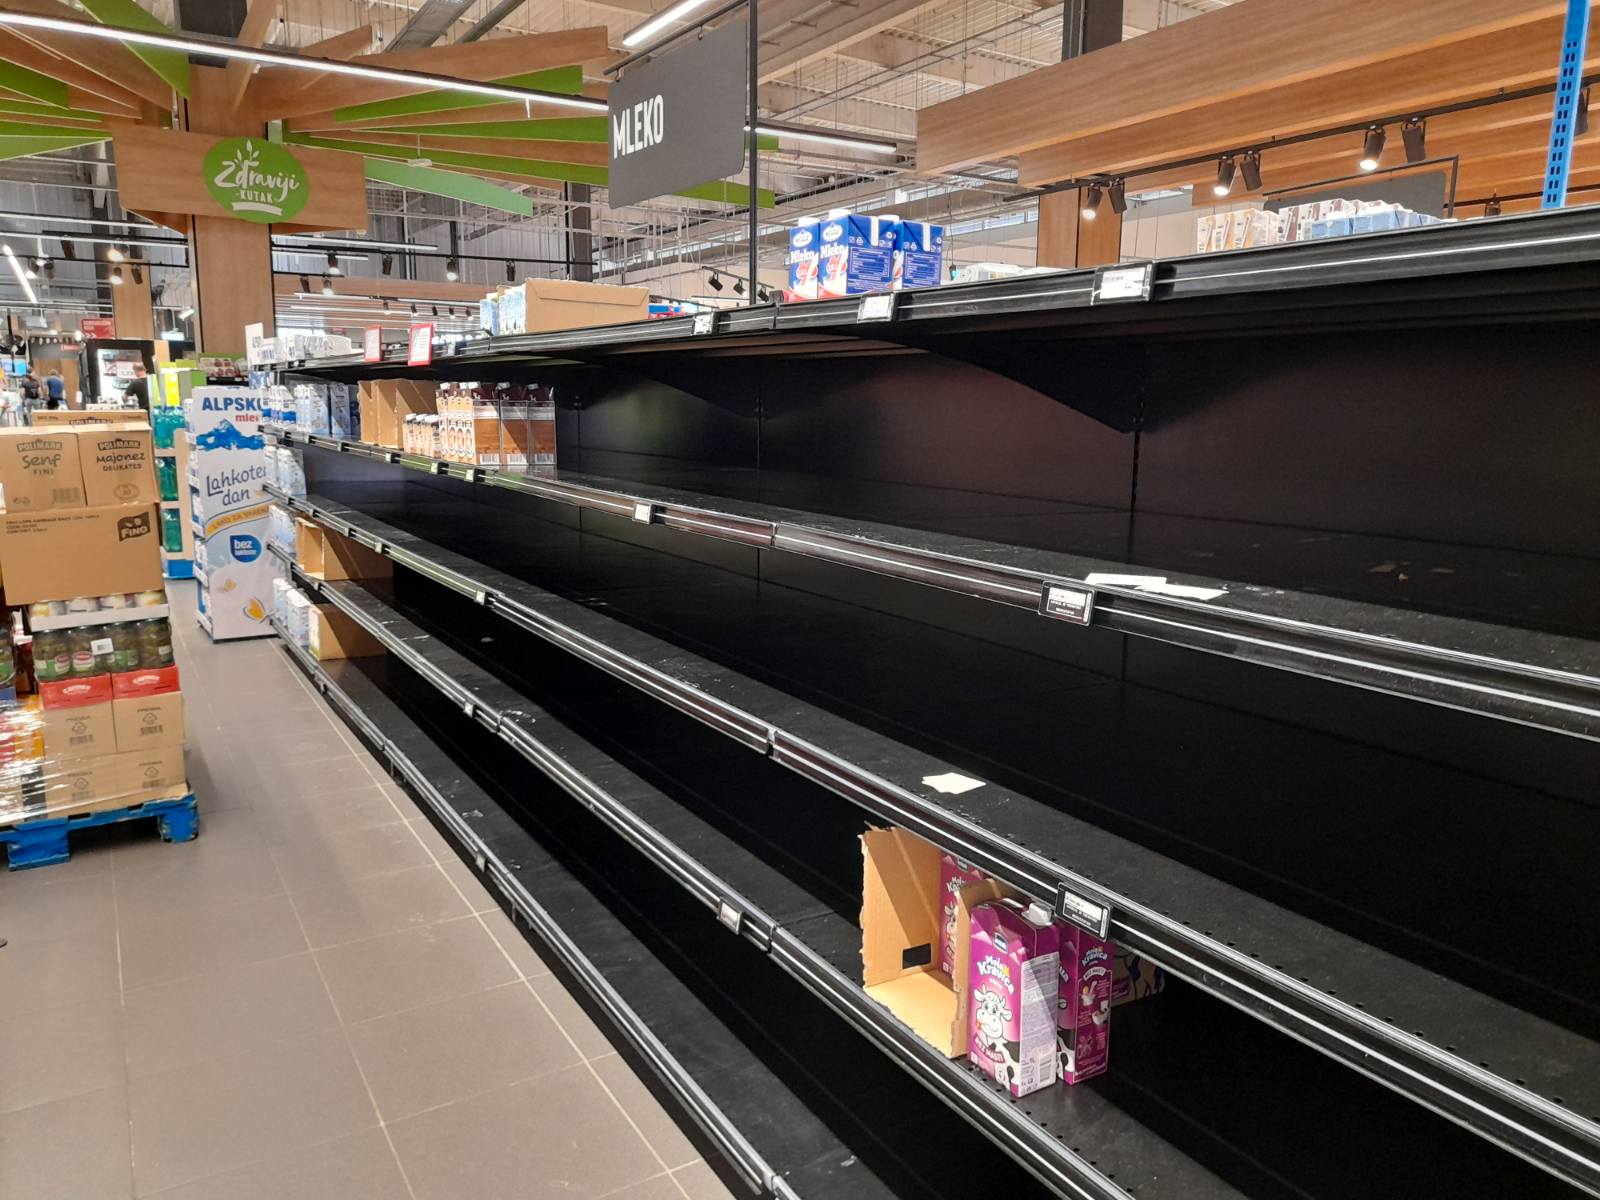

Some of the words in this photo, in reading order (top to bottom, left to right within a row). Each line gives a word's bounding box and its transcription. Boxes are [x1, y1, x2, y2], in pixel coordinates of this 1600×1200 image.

[613, 94, 664, 159] MLEKO
[214, 160, 300, 202] Zdraviji
[240, 190, 273, 203] KUTAK
[22, 454, 62, 469] Senf
[97, 452, 145, 464] Majonez
[222, 489, 250, 506] dan
[121, 525, 149, 538] FINO
[234, 539, 253, 549] bez
